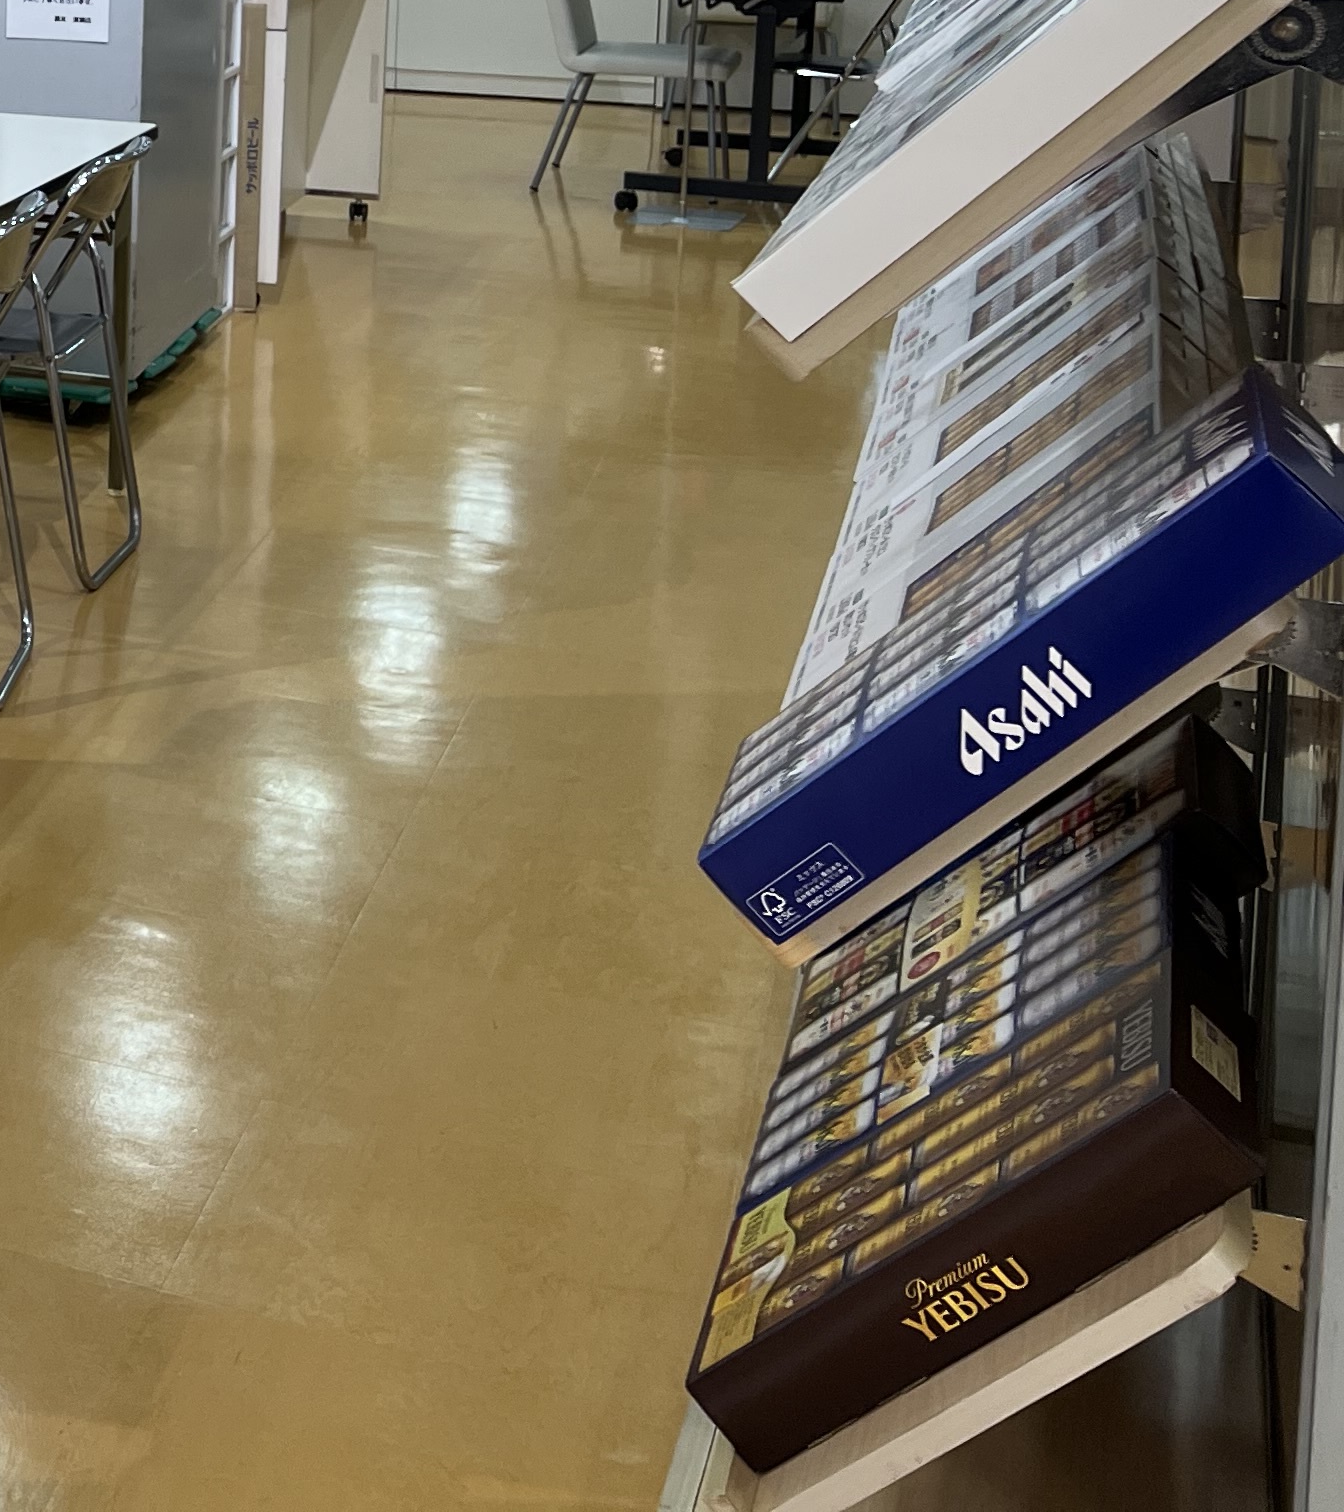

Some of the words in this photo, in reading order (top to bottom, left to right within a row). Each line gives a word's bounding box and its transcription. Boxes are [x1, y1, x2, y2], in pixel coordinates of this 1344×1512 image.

[245, 117, 260, 194] サッポロビール
[960, 646, 1093, 776] Asahi
[900, 1256, 1031, 1343] YEBISU
[905, 1252, 991, 1310] Premium
